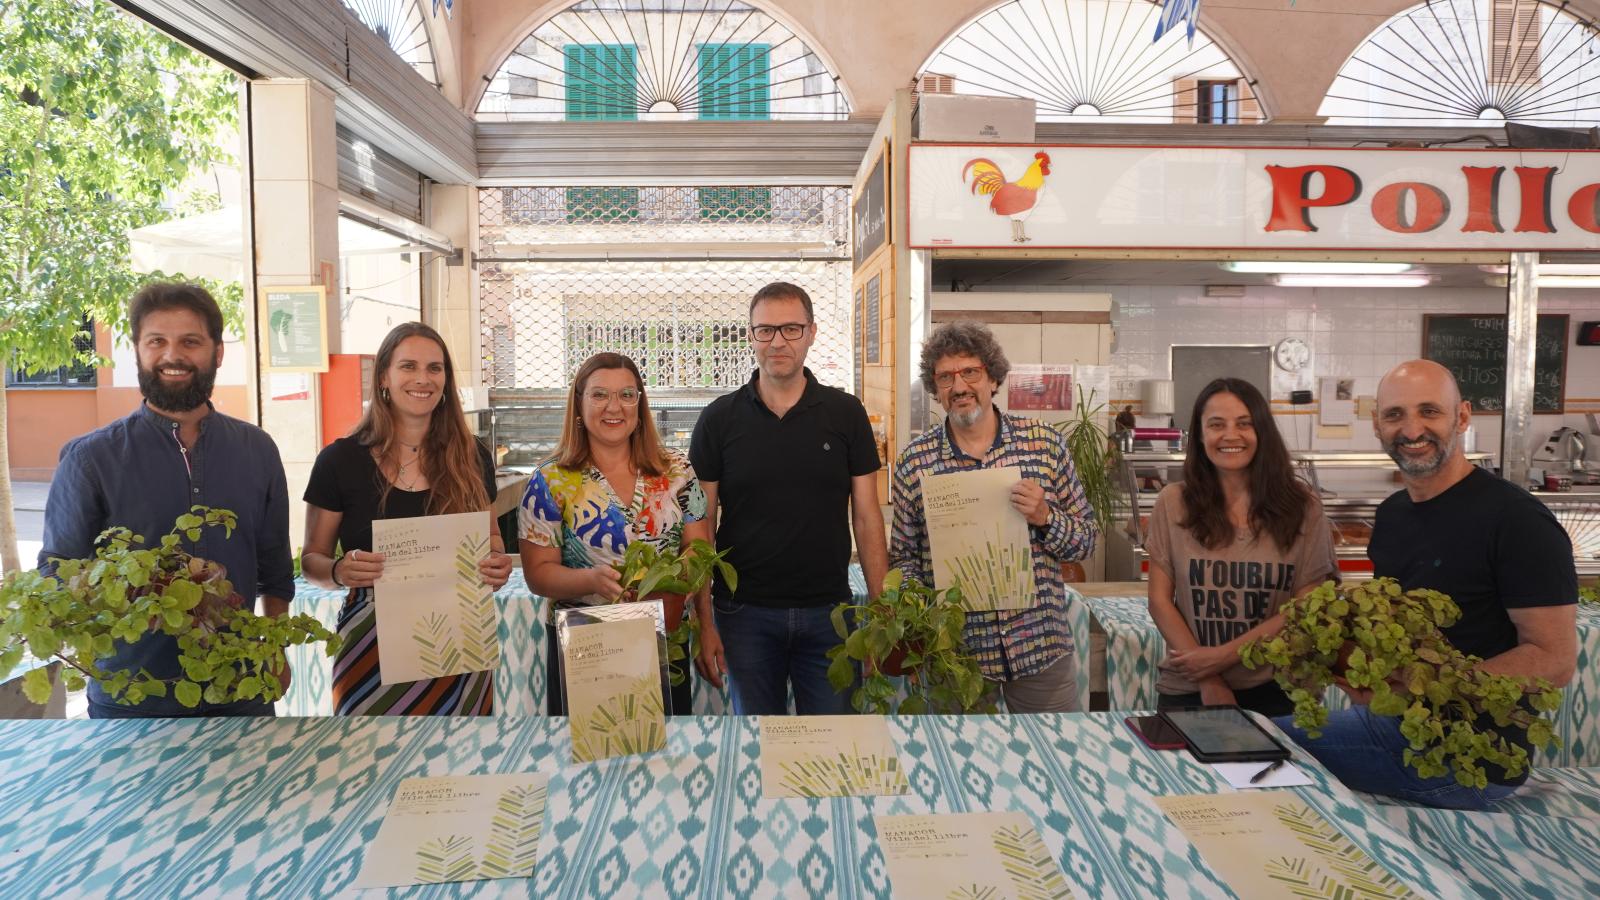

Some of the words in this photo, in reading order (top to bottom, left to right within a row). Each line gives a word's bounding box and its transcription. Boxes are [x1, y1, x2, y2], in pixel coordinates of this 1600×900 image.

[378, 539, 418, 551] MANACOR
[384, 550, 397, 558] ila
[1190, 559, 1294, 591] N'OUBLIE
[1192, 589, 1236, 619] PAS
[1244, 591, 1269, 619] DE
[1194, 619, 1260, 647] VIVR
